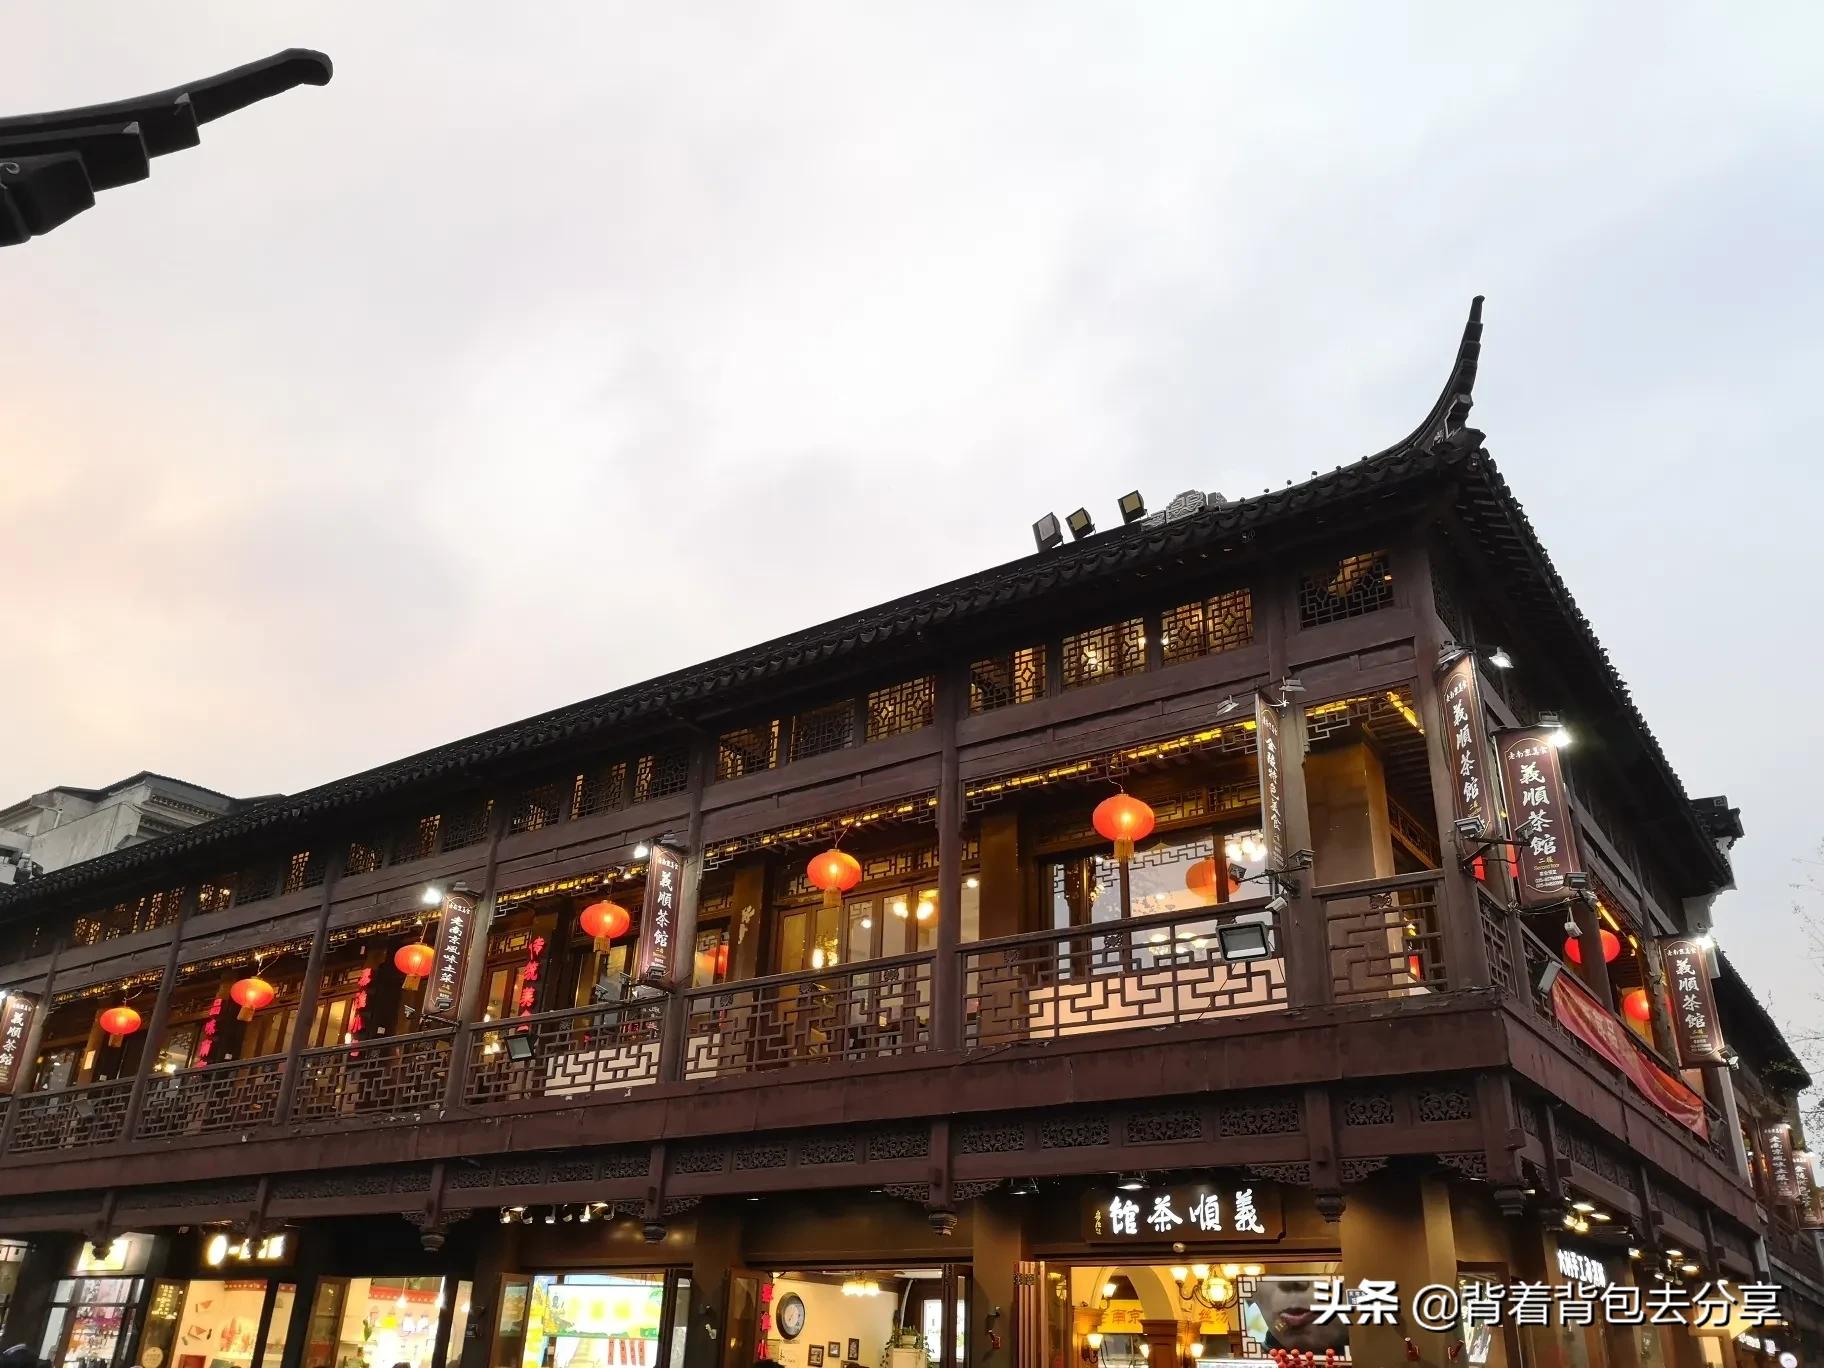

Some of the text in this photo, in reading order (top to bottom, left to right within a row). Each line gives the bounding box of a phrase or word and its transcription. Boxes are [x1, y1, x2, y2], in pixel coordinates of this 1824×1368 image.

[1519, 761, 1557, 856] 義順茶館
[1109, 1188, 1265, 1235] 義順茶館
